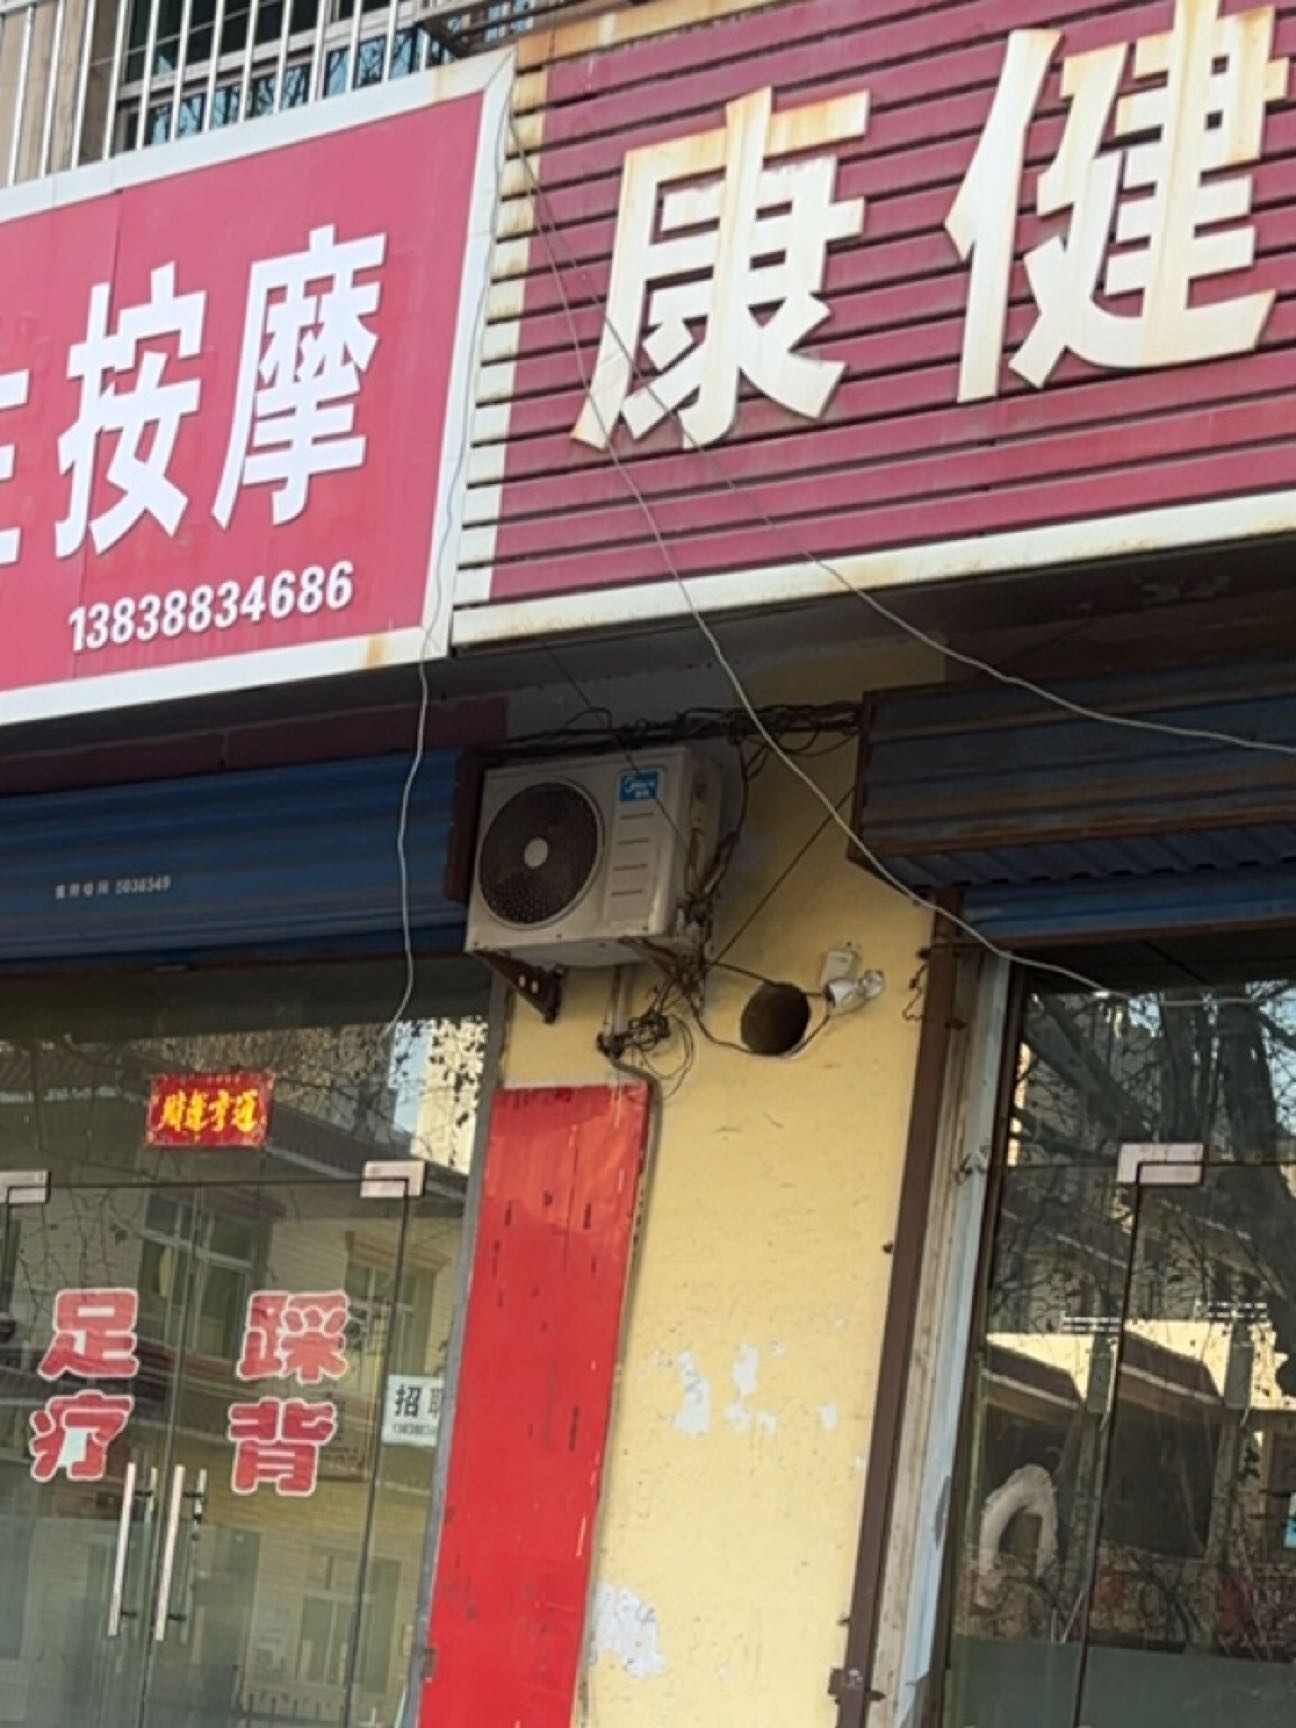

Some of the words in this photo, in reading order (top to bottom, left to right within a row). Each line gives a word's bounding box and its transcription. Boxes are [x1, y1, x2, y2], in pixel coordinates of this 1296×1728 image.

[67, 561, 355, 653] 13838834686
[29, 1288, 139, 1482] 足疗
[227, 1290, 349, 1496] 踩背
